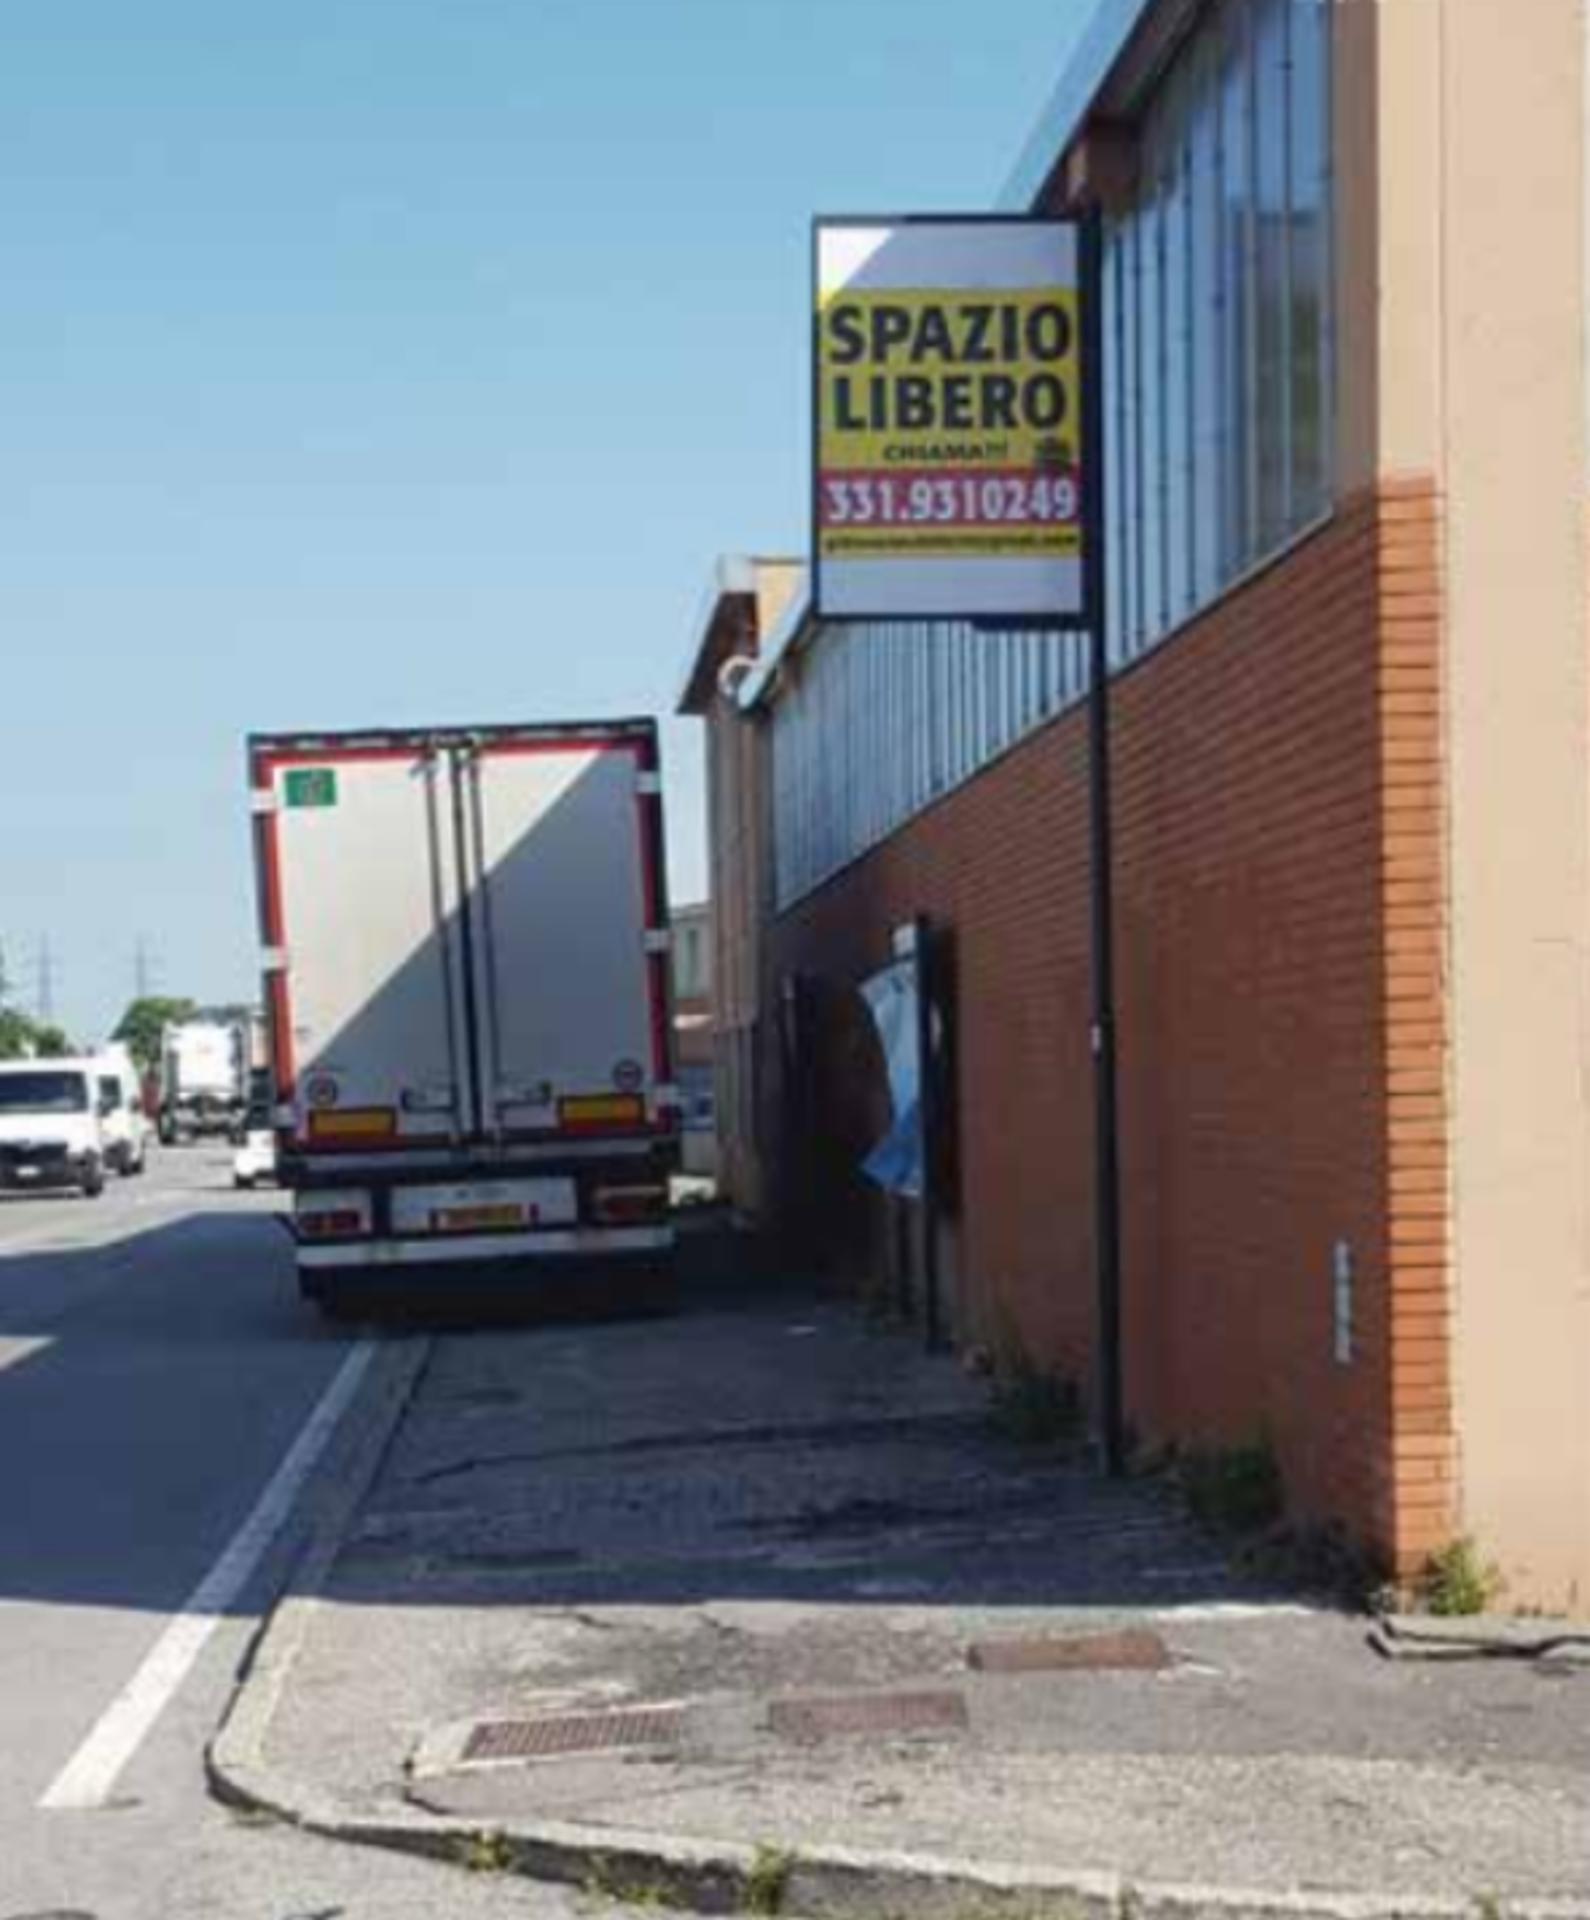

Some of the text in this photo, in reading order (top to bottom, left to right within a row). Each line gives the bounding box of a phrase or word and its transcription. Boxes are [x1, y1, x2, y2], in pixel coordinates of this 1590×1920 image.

[828, 304, 1071, 364] SPAZIO
[833, 375, 1067, 430] LIBERO
[827, 479, 1077, 520] 331.9310249
